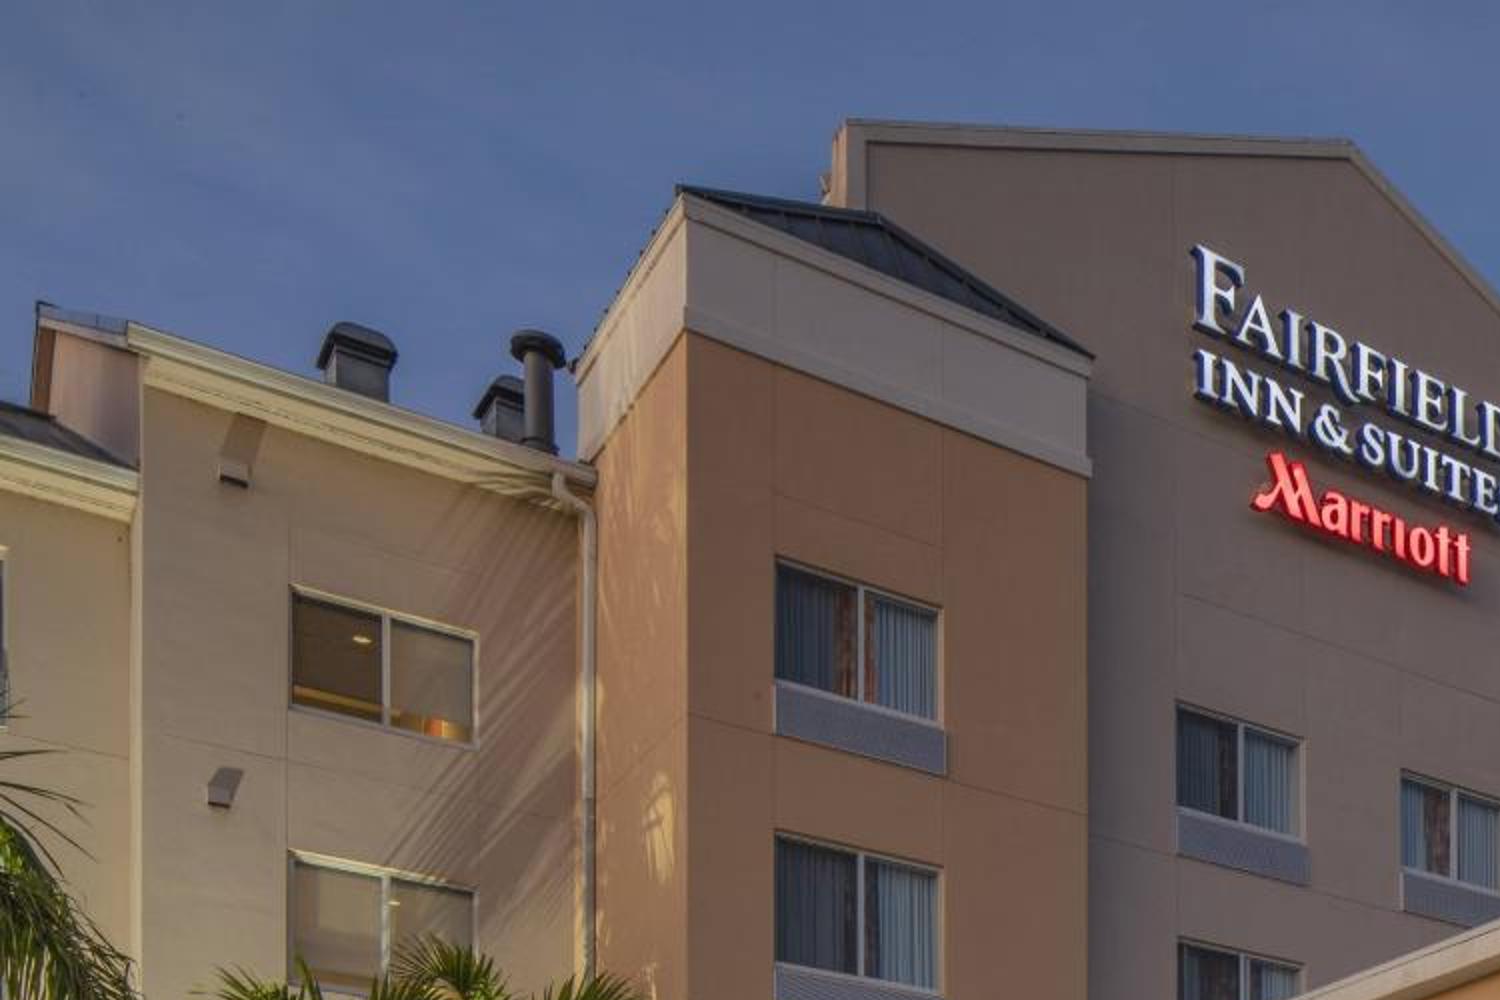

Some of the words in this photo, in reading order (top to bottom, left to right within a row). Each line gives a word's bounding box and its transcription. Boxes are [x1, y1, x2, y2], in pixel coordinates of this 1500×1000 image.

[1194, 349, 1304, 435] INN
[1311, 403, 1353, 455] &
[1250, 451, 1471, 587] Marriott
